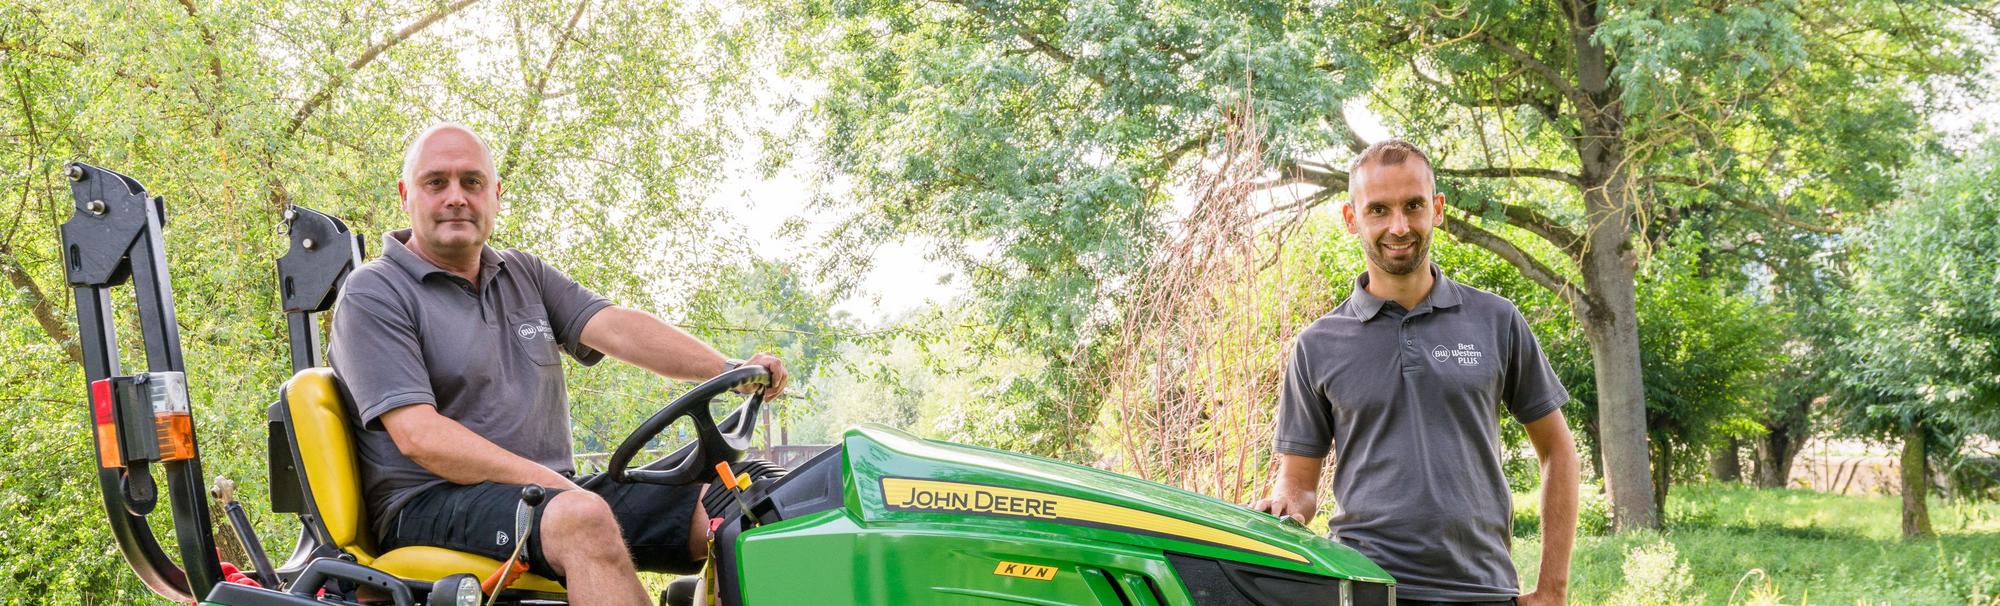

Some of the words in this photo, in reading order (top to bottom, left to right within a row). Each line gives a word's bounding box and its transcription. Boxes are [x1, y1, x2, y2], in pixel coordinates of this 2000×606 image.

[1451, 349, 1482, 357] Western
[902, 487, 968, 508] JOHN
[974, 490, 1057, 516] DEERE
